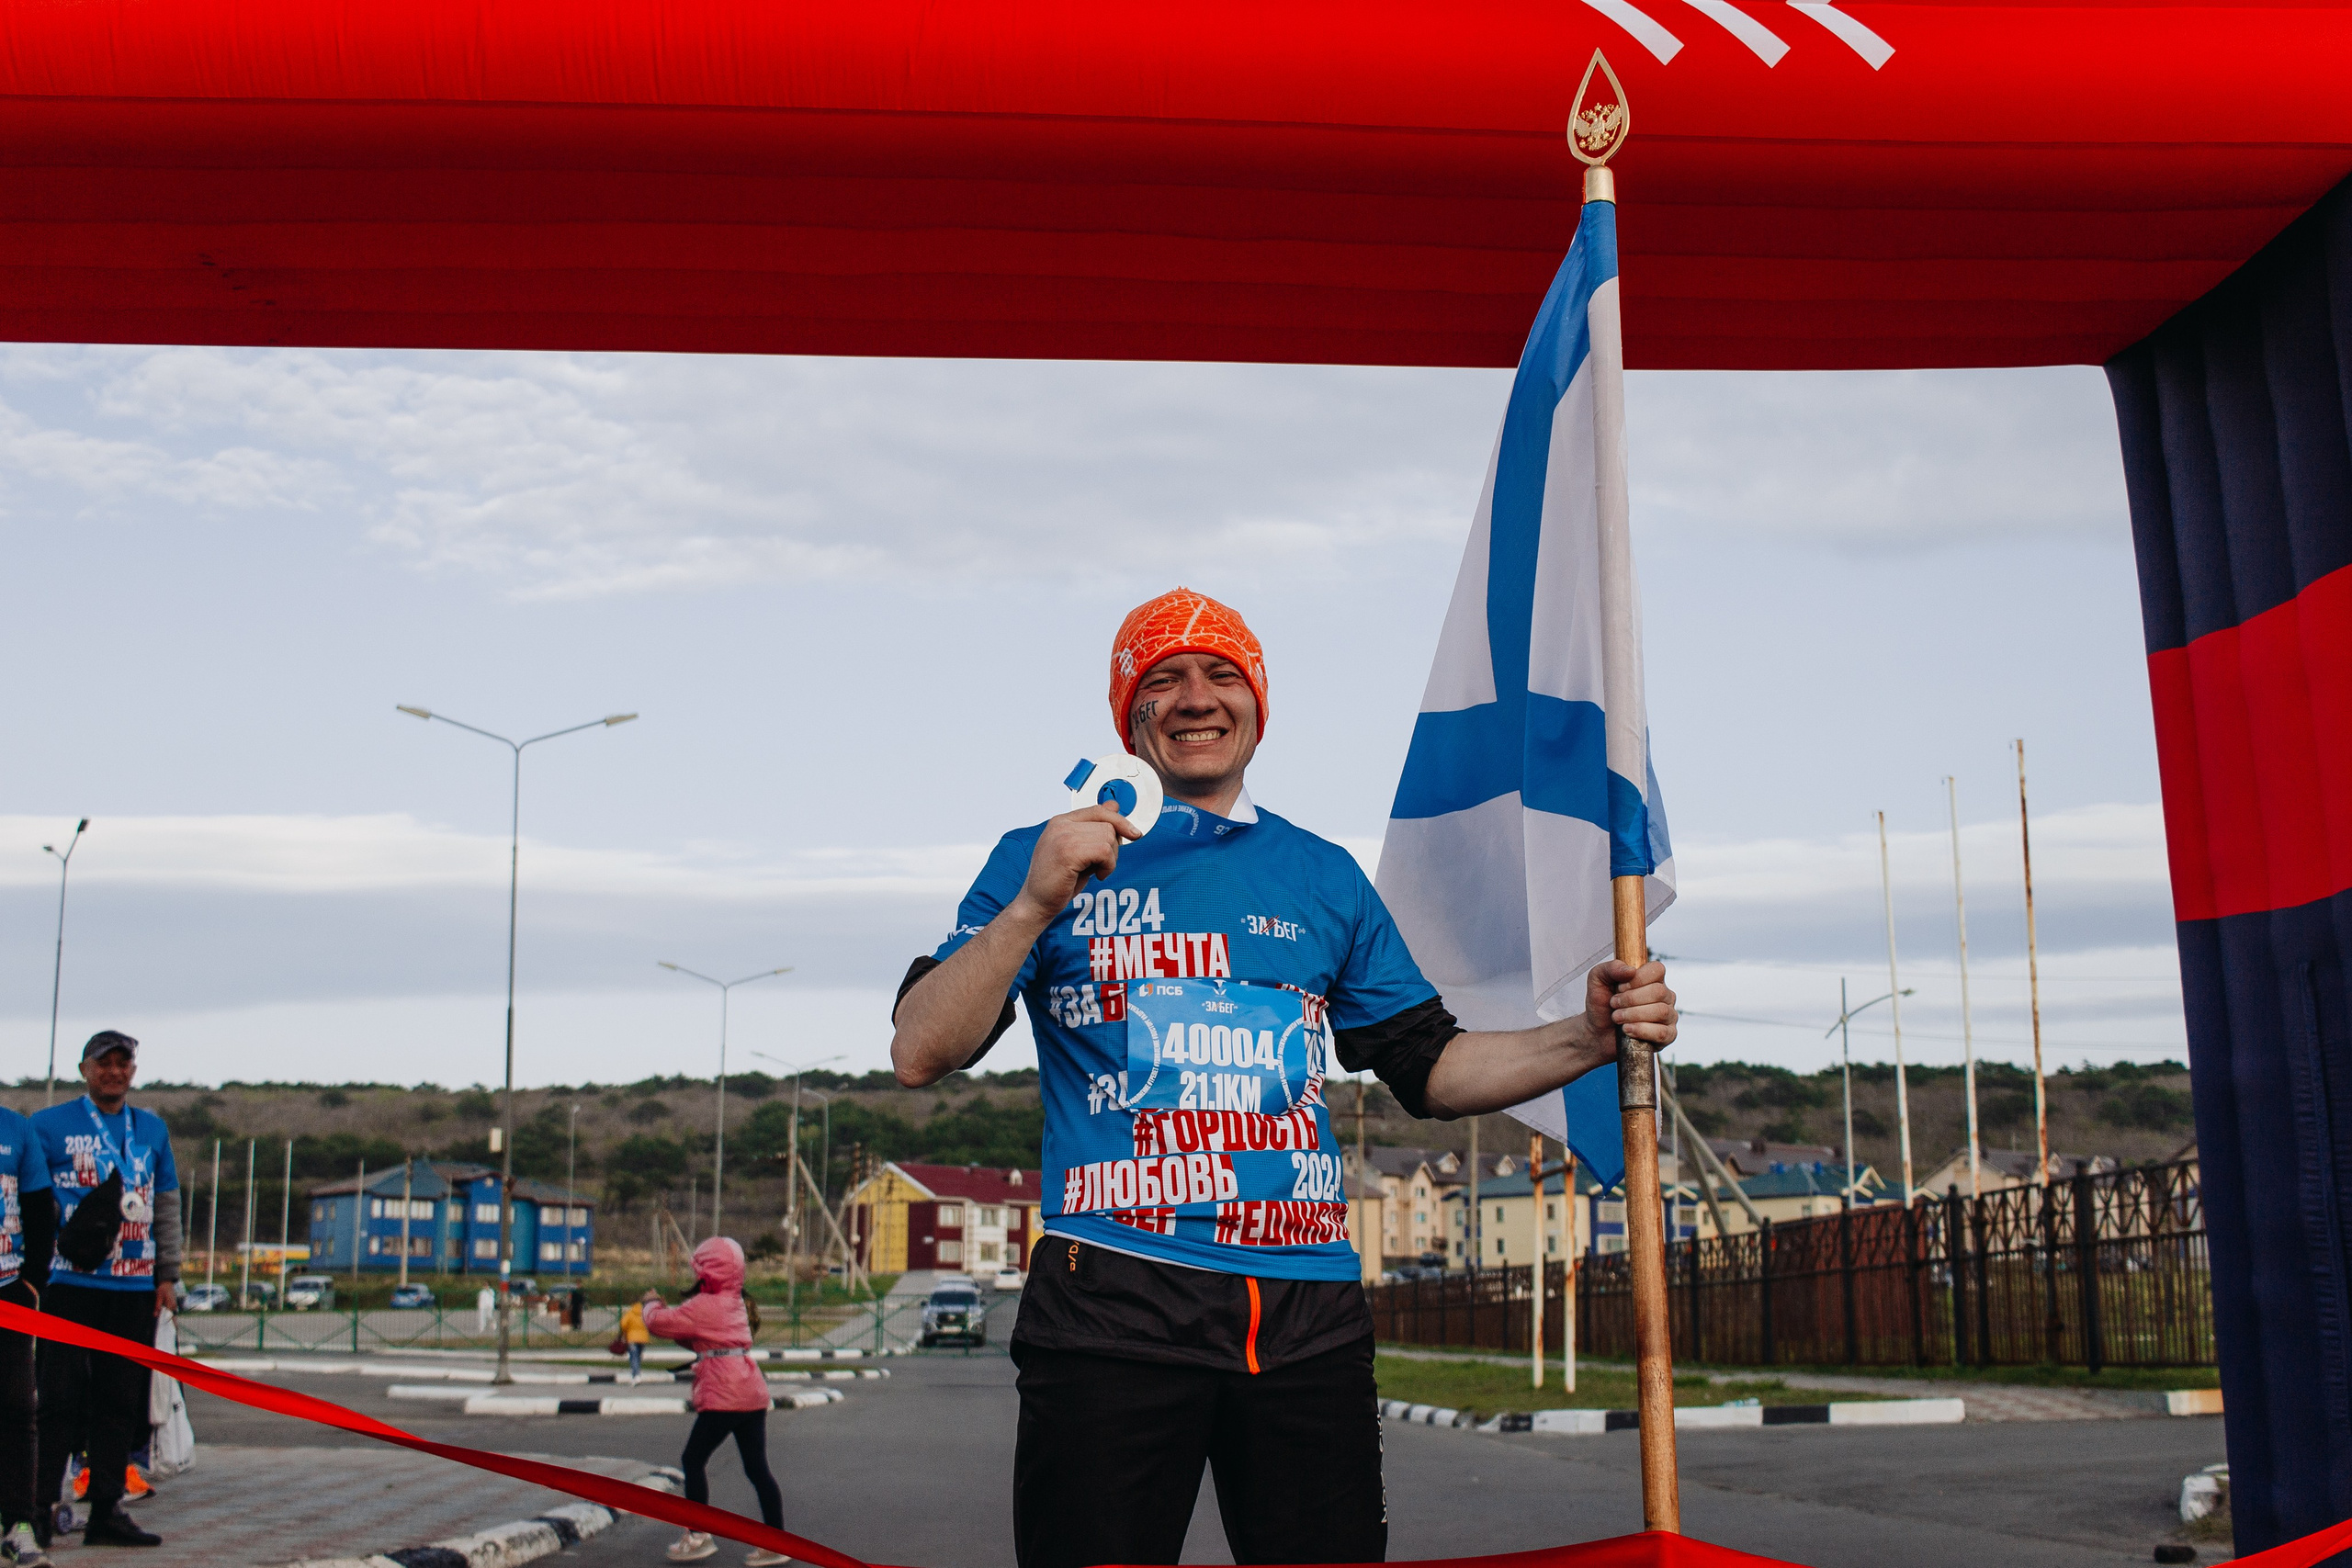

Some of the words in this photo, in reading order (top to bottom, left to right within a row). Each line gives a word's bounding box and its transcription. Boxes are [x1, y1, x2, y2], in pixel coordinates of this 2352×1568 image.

[1072, 887, 1165, 936] 2024
[1090, 932, 1231, 981] #МЕЧТА
[1049, 983, 1128, 1029] #ЗАБ
[1157, 986, 1183, 996] ПСБ
[1162, 1022, 1280, 1070] 40004
[64, 1134, 102, 1155] 2024
[1134, 1106, 1320, 1156] #ГОРДОСТЬ
[1062, 1154, 1238, 1213] #ЛЮБОВЬ
